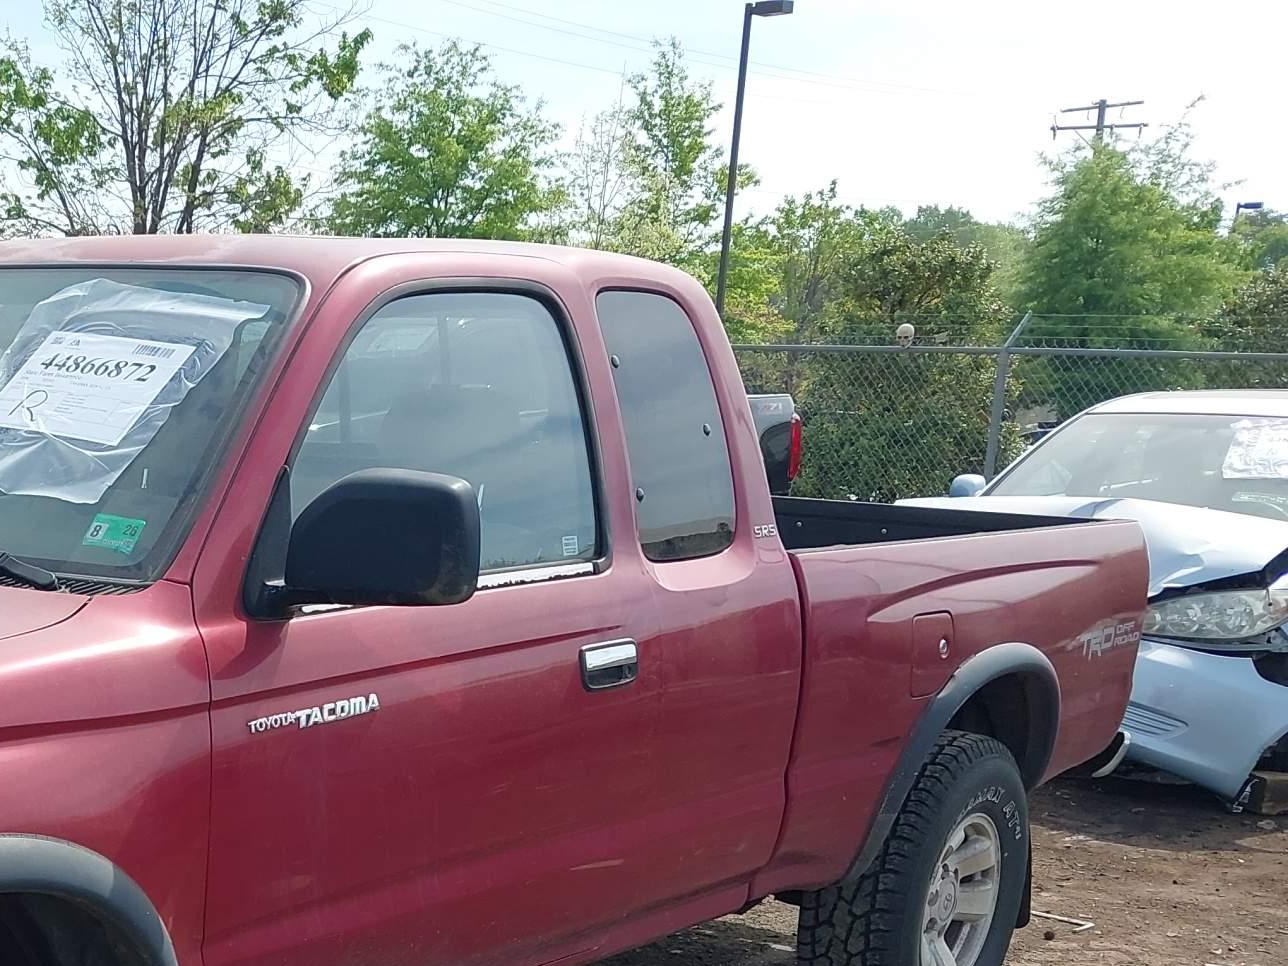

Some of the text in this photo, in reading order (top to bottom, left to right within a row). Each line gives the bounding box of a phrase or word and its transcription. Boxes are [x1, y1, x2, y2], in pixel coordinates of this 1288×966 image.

[41, 352, 158, 383] 44866872
[8, 389, 49, 422] R
[90, 524, 102, 538] 8
[123, 524, 138, 537] 26
[1114, 631, 1140, 647] ROAD
[1116, 621, 1136, 634] OFF
[1080, 627, 1115, 661] TRD
[247, 693, 381, 734] TOYOTA TACOMA
